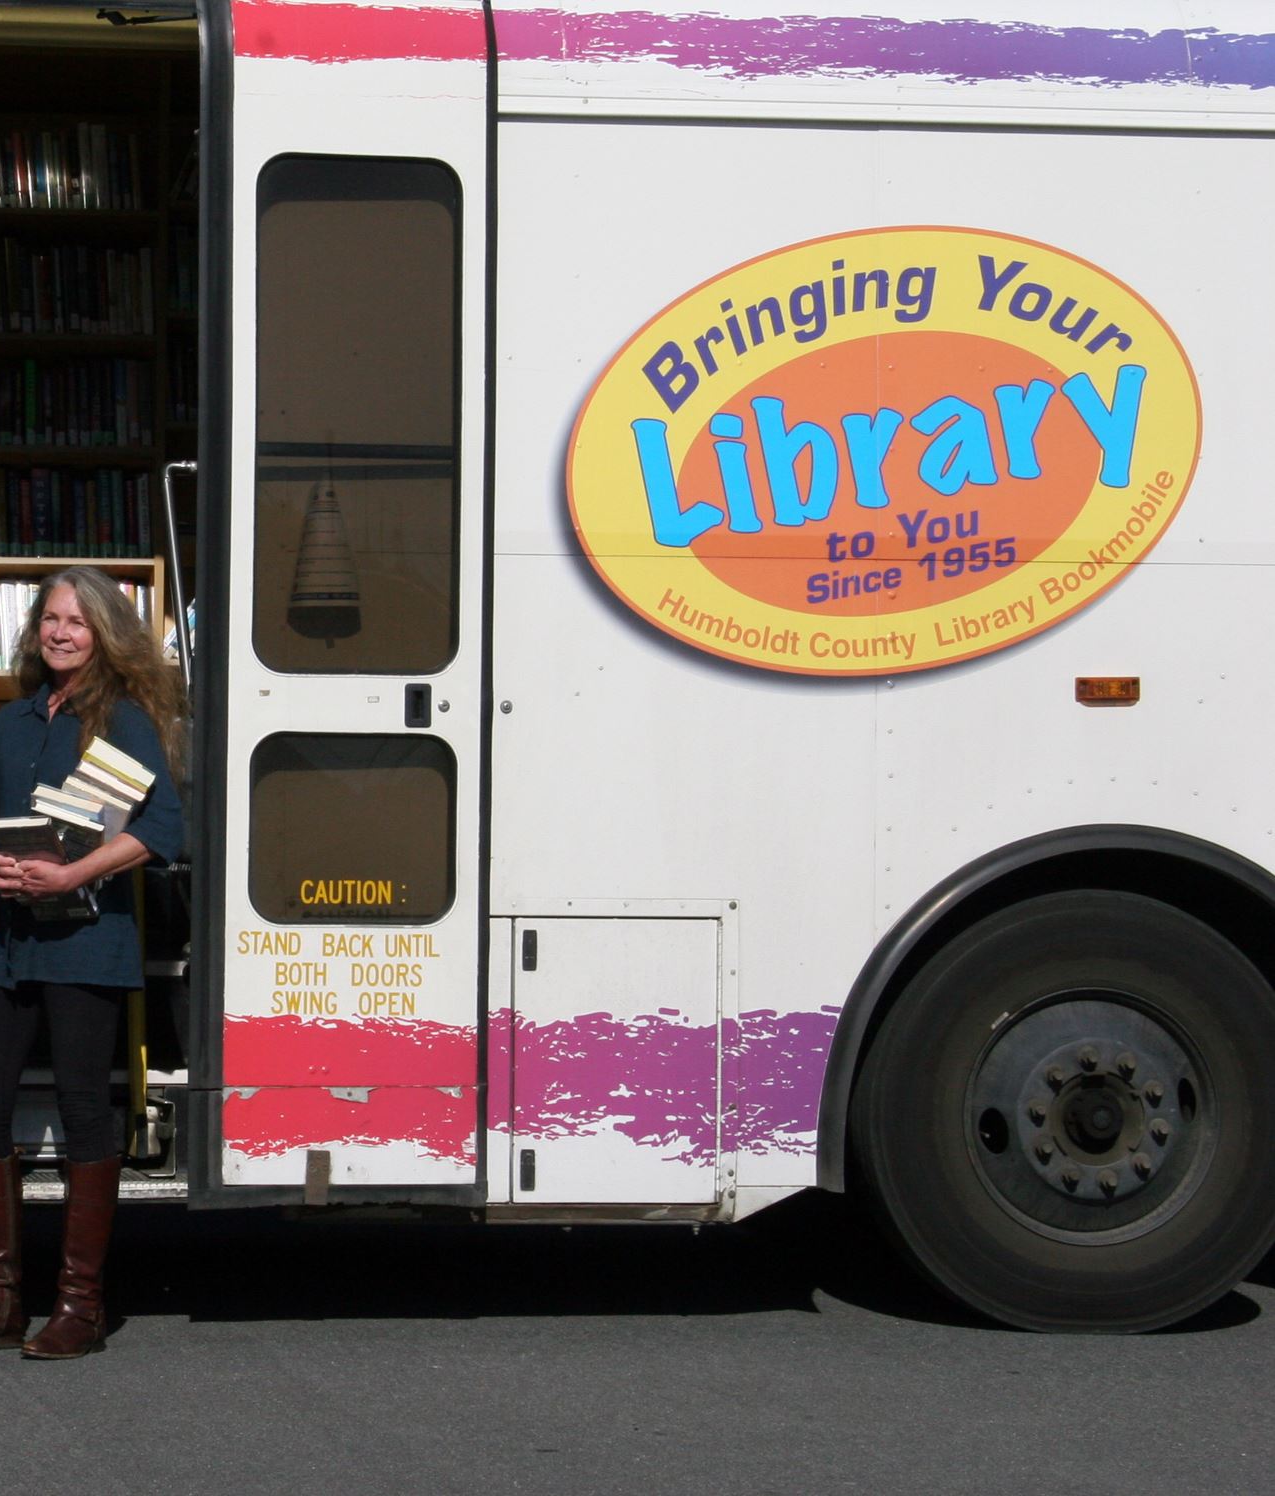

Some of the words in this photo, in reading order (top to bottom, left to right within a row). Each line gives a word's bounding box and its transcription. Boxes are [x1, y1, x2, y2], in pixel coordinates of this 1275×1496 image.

[642, 259, 937, 414] Bringing
[977, 255, 1133, 354] Your
[631, 364, 1147, 548] Library
[827, 527, 875, 562] to
[898, 509, 979, 549] You
[657, 588, 800, 655] Humboldt
[809, 630, 917, 660] County
[934, 595, 1037, 648] Library
[1040, 469, 1175, 604] Bookmobile
[806, 565, 902, 604] Since
[918, 537, 1016, 581] 1955
[300, 880, 392, 905] CAUTION
[237, 931, 302, 955] STAND
[322, 934, 374, 957] BACK
[385, 934, 440, 958] UNTIL
[275, 962, 327, 986] BOTH
[351, 963, 423, 987] DOORS
[271, 991, 338, 1015] SWING
[359, 992, 415, 1016] OPEN
